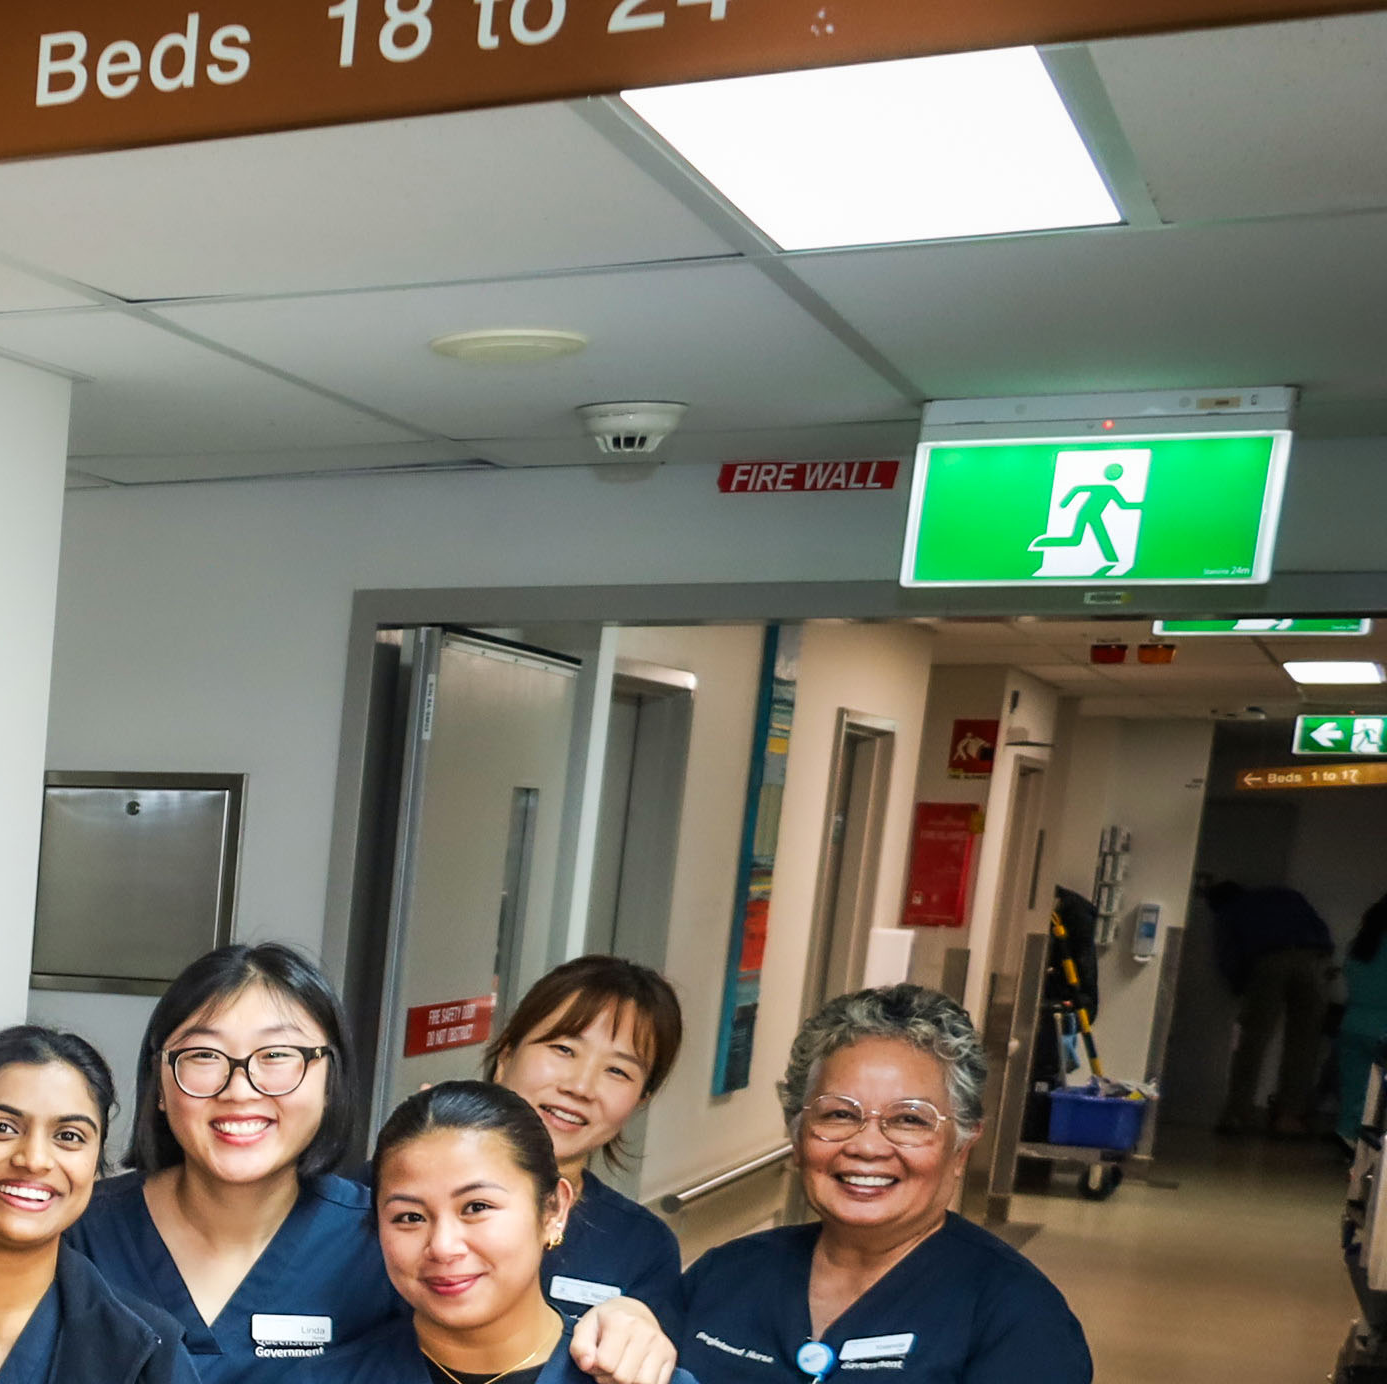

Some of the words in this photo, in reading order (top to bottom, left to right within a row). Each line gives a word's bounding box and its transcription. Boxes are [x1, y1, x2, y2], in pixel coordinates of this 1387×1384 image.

[34, 13, 252, 107] Beds
[327, 0, 434, 68] 18
[474, 0, 567, 51] to
[729, 463, 789, 492] FIRE
[802, 461, 883, 491] WALL
[1267, 773, 1302, 783] Beds
[1322, 770, 1336, 781] to
[428, 1008, 440, 1025] FIRE
[426, 1031, 435, 1047] DO
[435, 1028, 447, 1045] NOT
[301, 1325, 325, 1335] Linda
[255, 1346, 325, 1358] Government
[695, 1331, 746, 1356] Registered
[746, 1350, 775, 1364] Nurse
